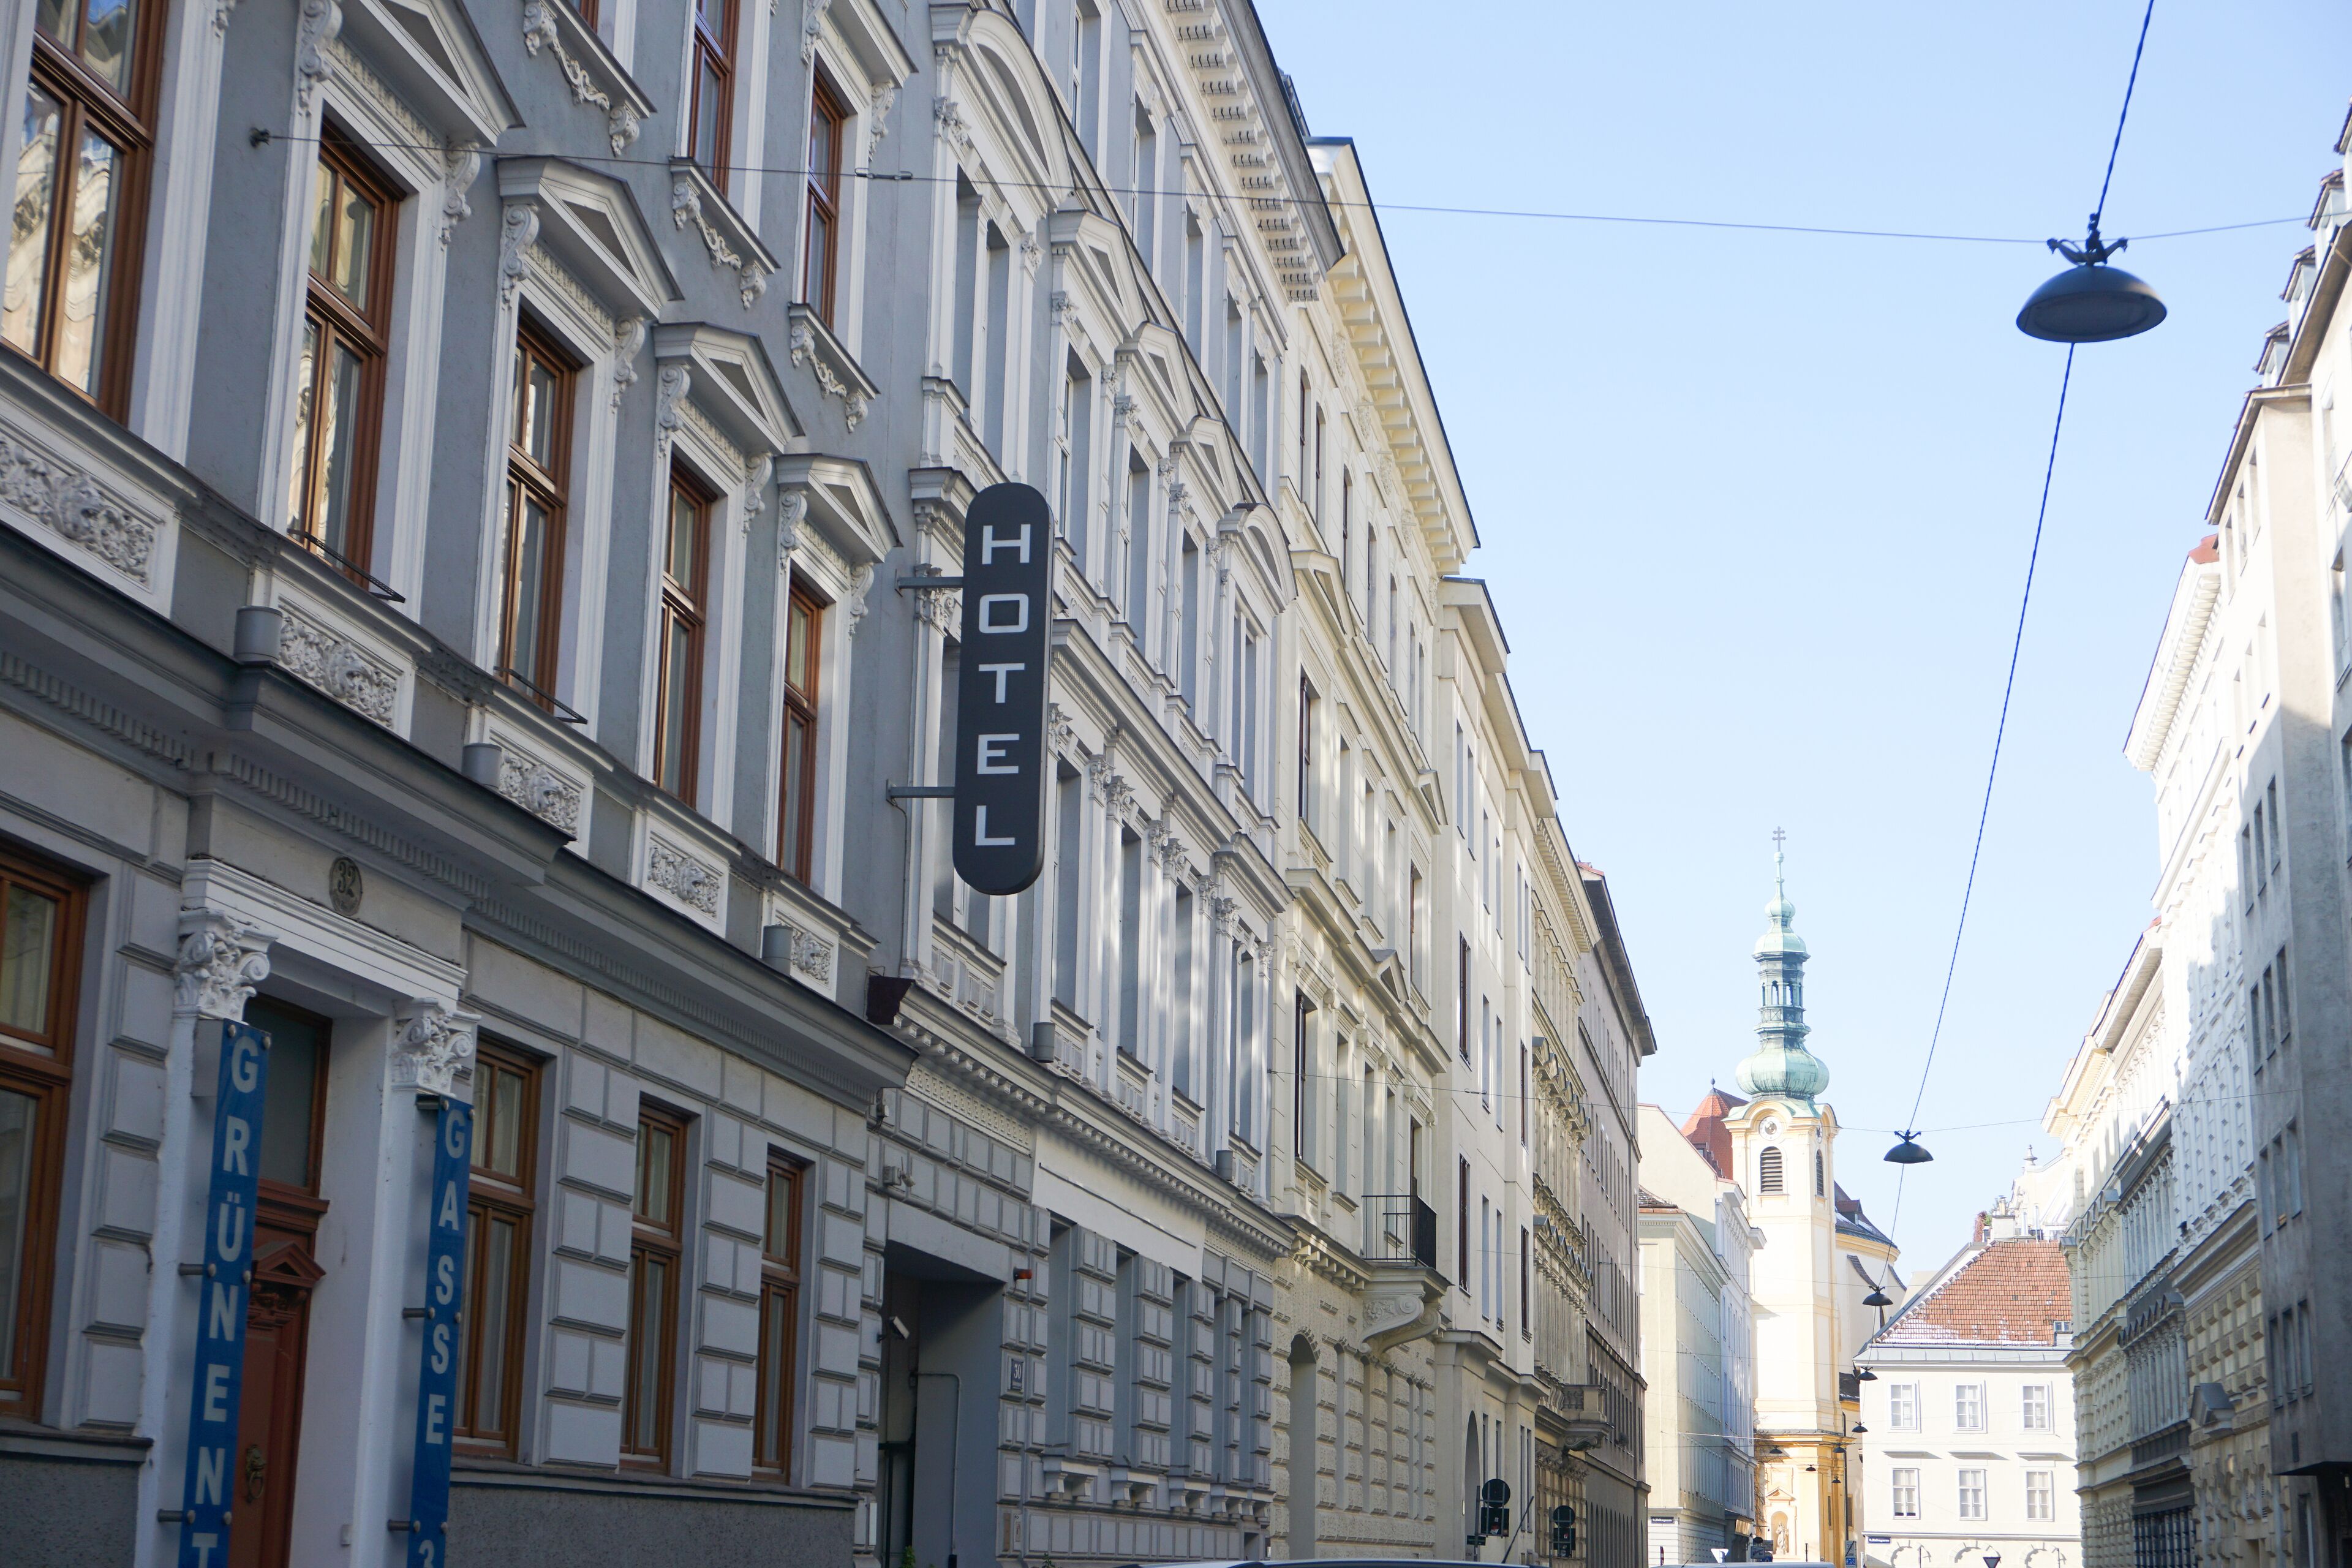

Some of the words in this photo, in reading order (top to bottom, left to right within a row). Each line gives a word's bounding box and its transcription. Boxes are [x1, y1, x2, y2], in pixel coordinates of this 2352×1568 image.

[975, 524, 1030, 846] HOTEL
[338, 861, 355, 897] 32
[192, 1035, 258, 1568] GRÜNENT
[425, 1109, 467, 1446] GASSE
[1014, 1363, 1022, 1379] 30
